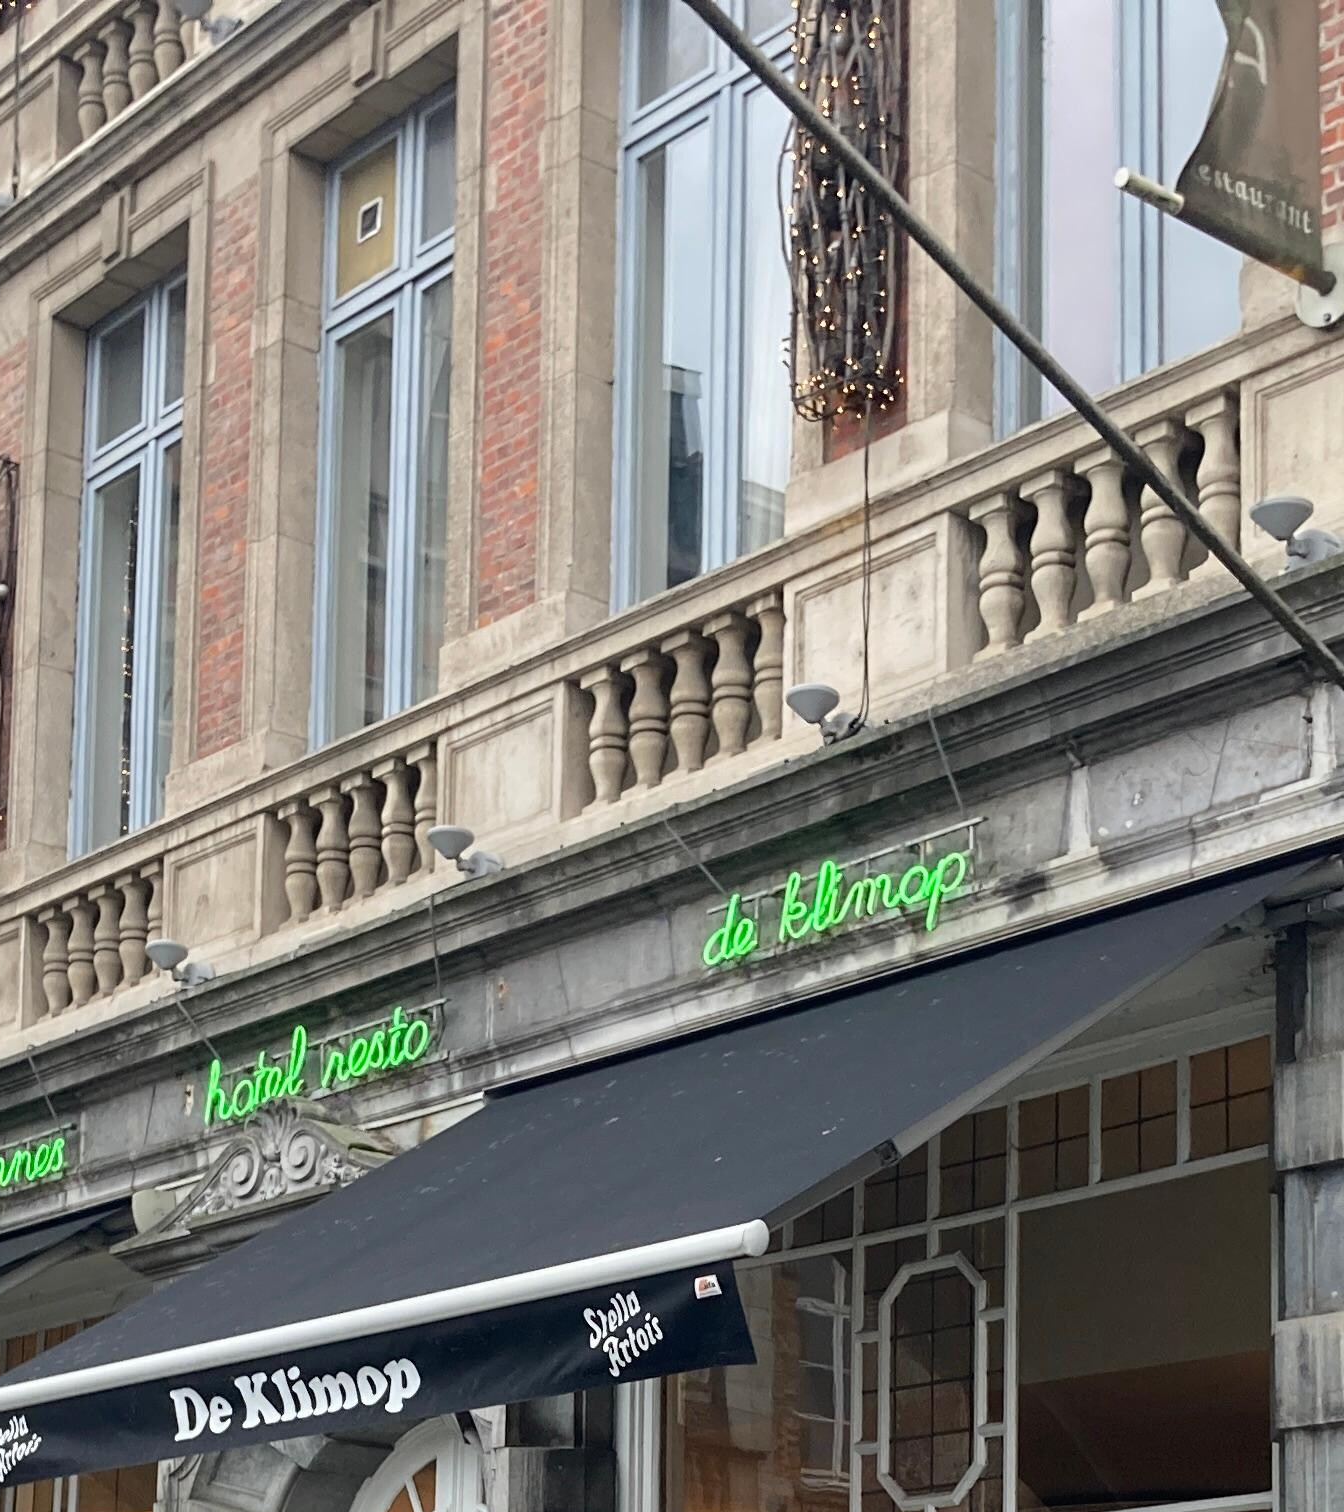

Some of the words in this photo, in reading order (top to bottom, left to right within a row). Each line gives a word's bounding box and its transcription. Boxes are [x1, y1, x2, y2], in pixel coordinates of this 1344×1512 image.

[703, 893, 758, 965] de
[779, 852, 967, 931] klimop
[204, 1025, 307, 1125] hotel
[321, 1006, 429, 1089] resto
[583, 1290, 641, 1349] Stella
[603, 1313, 664, 1377] Artois
[169, 1387, 233, 1441] De
[234, 1358, 421, 1429] Klimop
